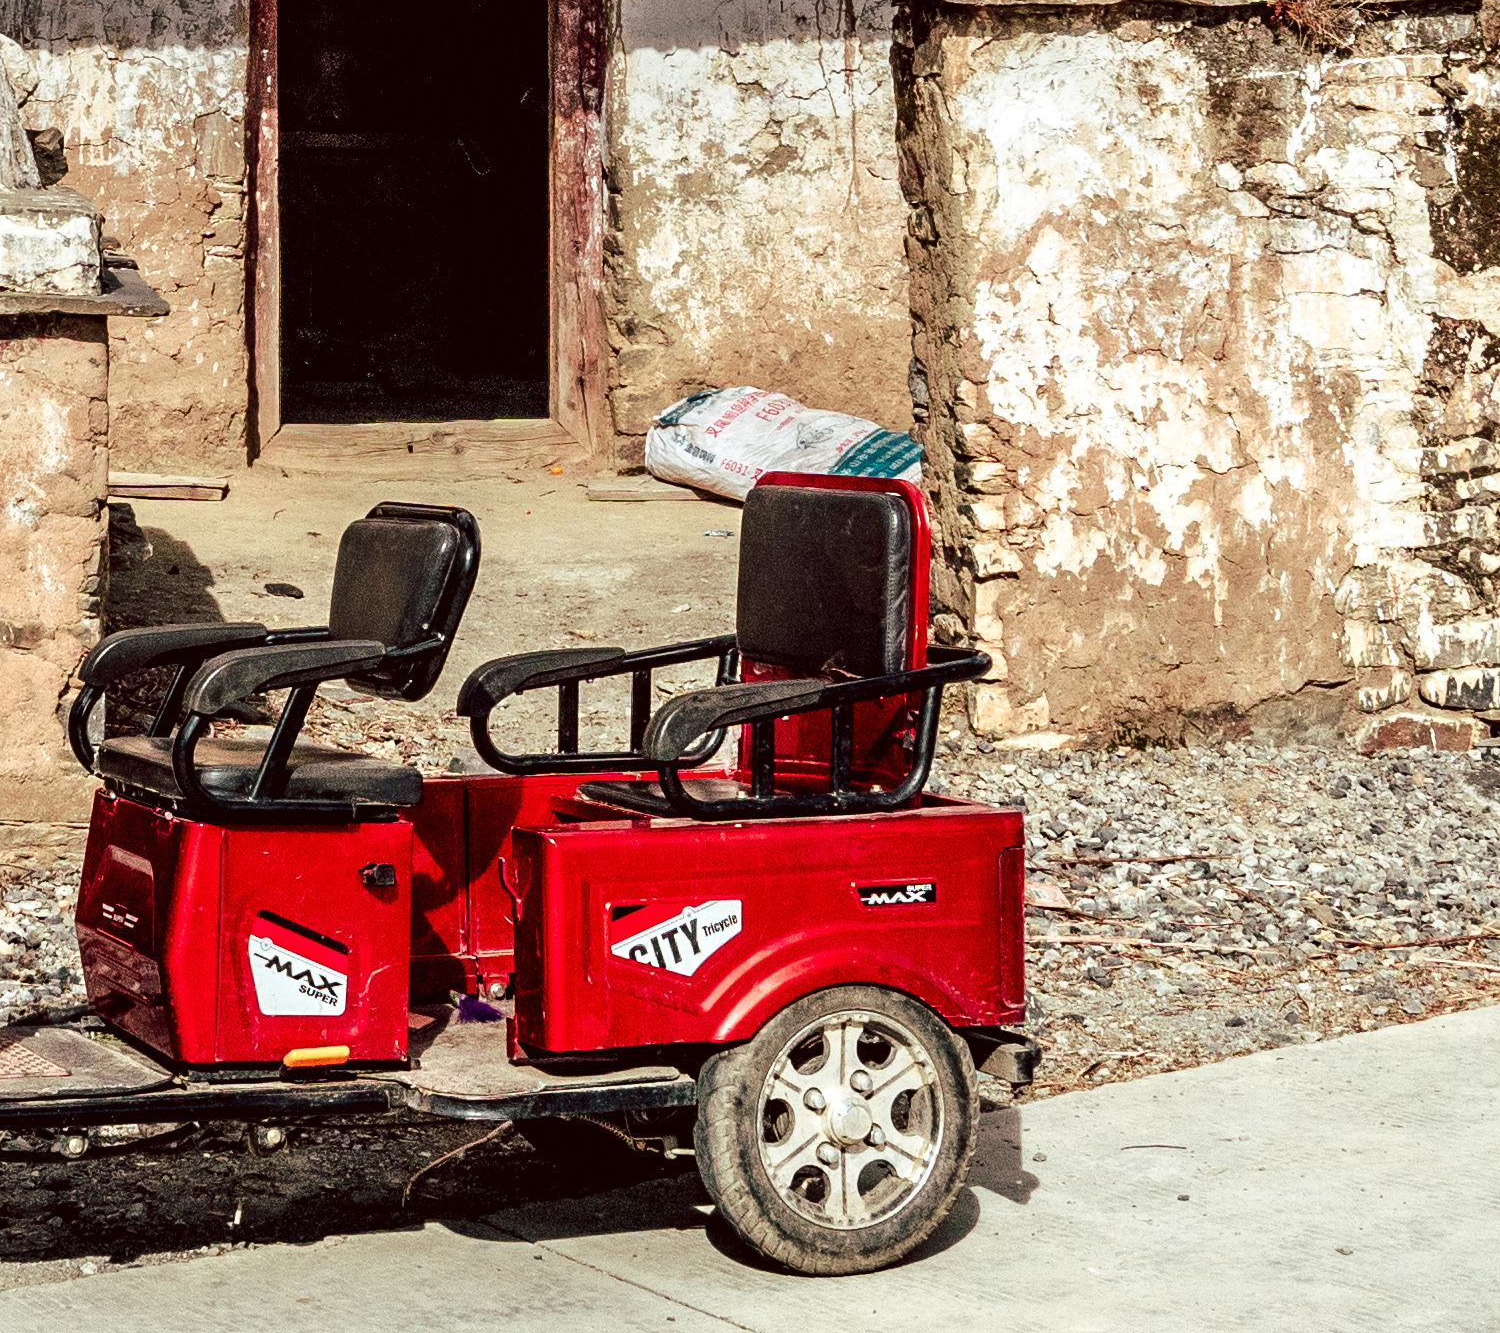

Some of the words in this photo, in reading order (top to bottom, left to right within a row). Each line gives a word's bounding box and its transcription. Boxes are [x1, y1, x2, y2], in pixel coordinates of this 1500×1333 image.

[720, 458, 749, 477] F6031
[860, 891, 927, 905] MAX
[906, 884, 932, 892] SUPER
[702, 914, 738, 937] Tricycle
[254, 954, 343, 998] MAX
[298, 984, 339, 1007] SUPER
